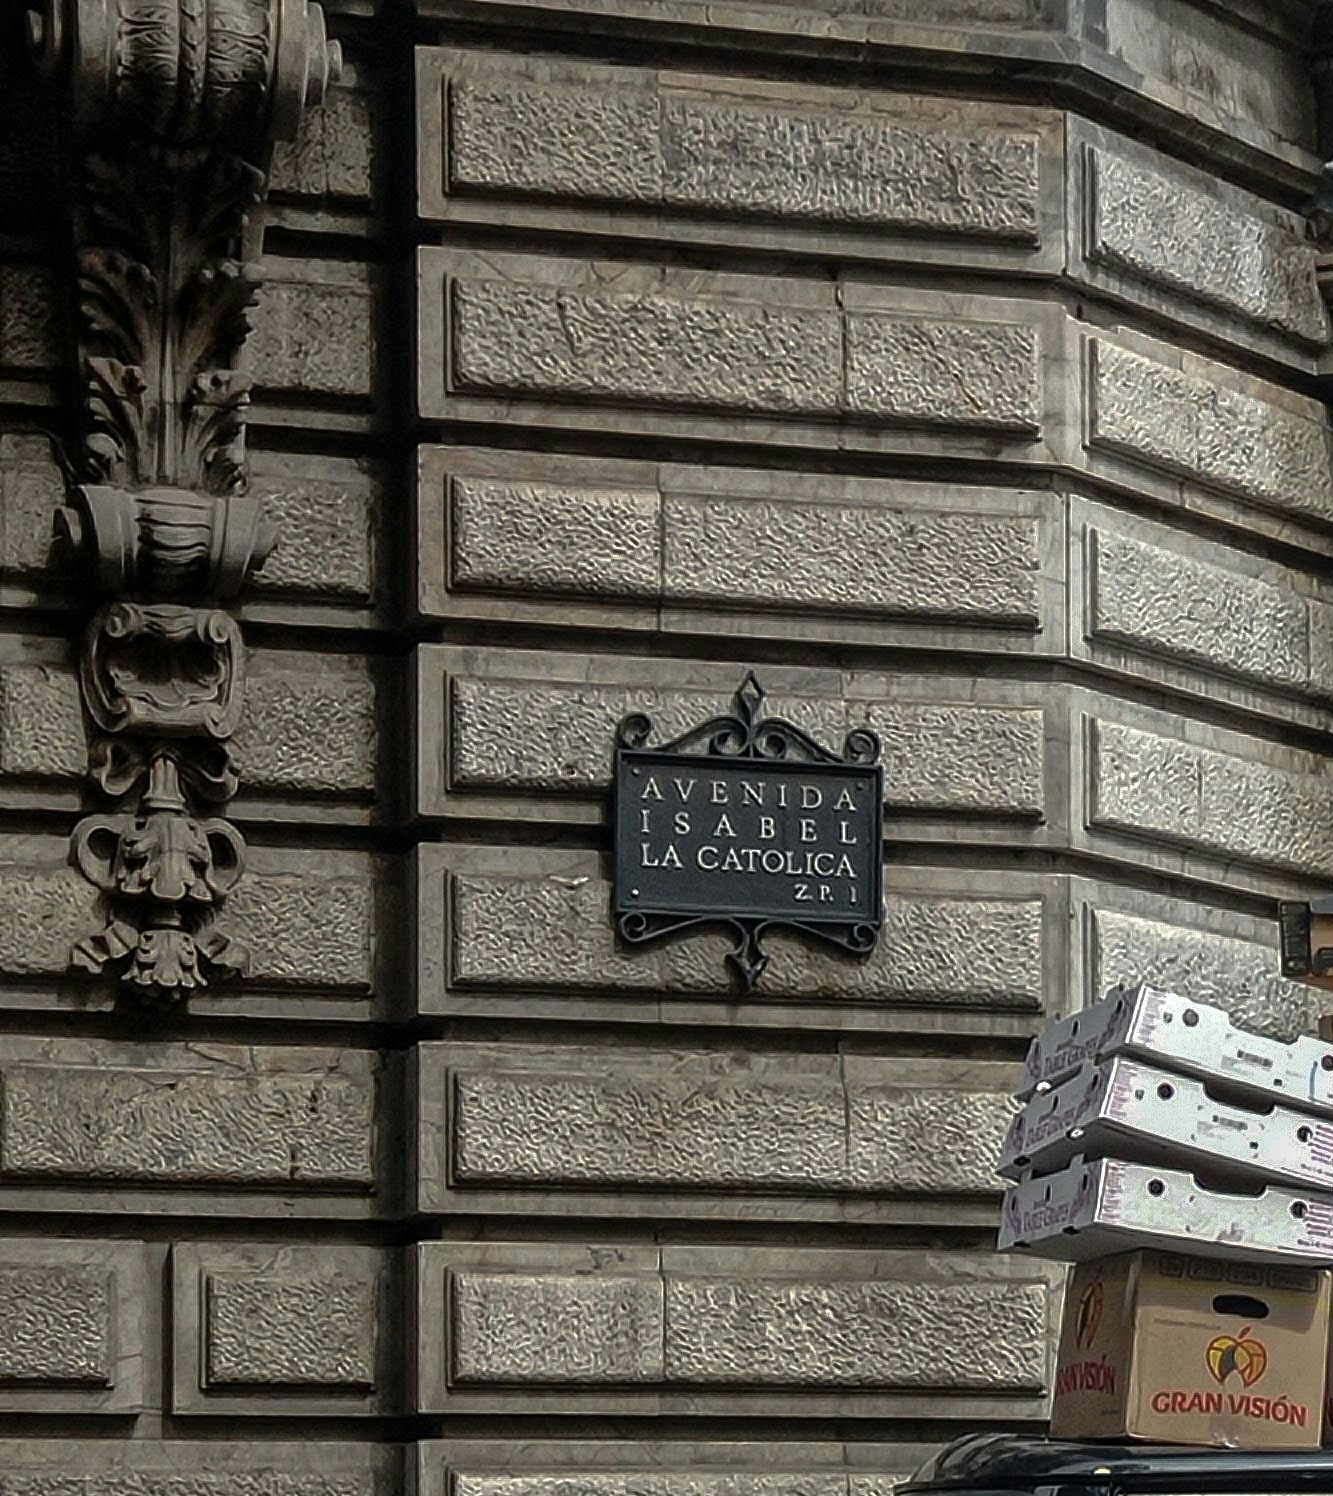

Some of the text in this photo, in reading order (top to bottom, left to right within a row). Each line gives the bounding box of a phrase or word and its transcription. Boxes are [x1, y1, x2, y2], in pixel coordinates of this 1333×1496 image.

[640, 776, 858, 812] AVENIDA
[640, 809, 858, 845] ISABEL
[640, 843, 858, 878] LA CATOLICA
[1151, 1391, 1223, 1415] GRAN
[1227, 1395, 1308, 1428] VISIÓN
